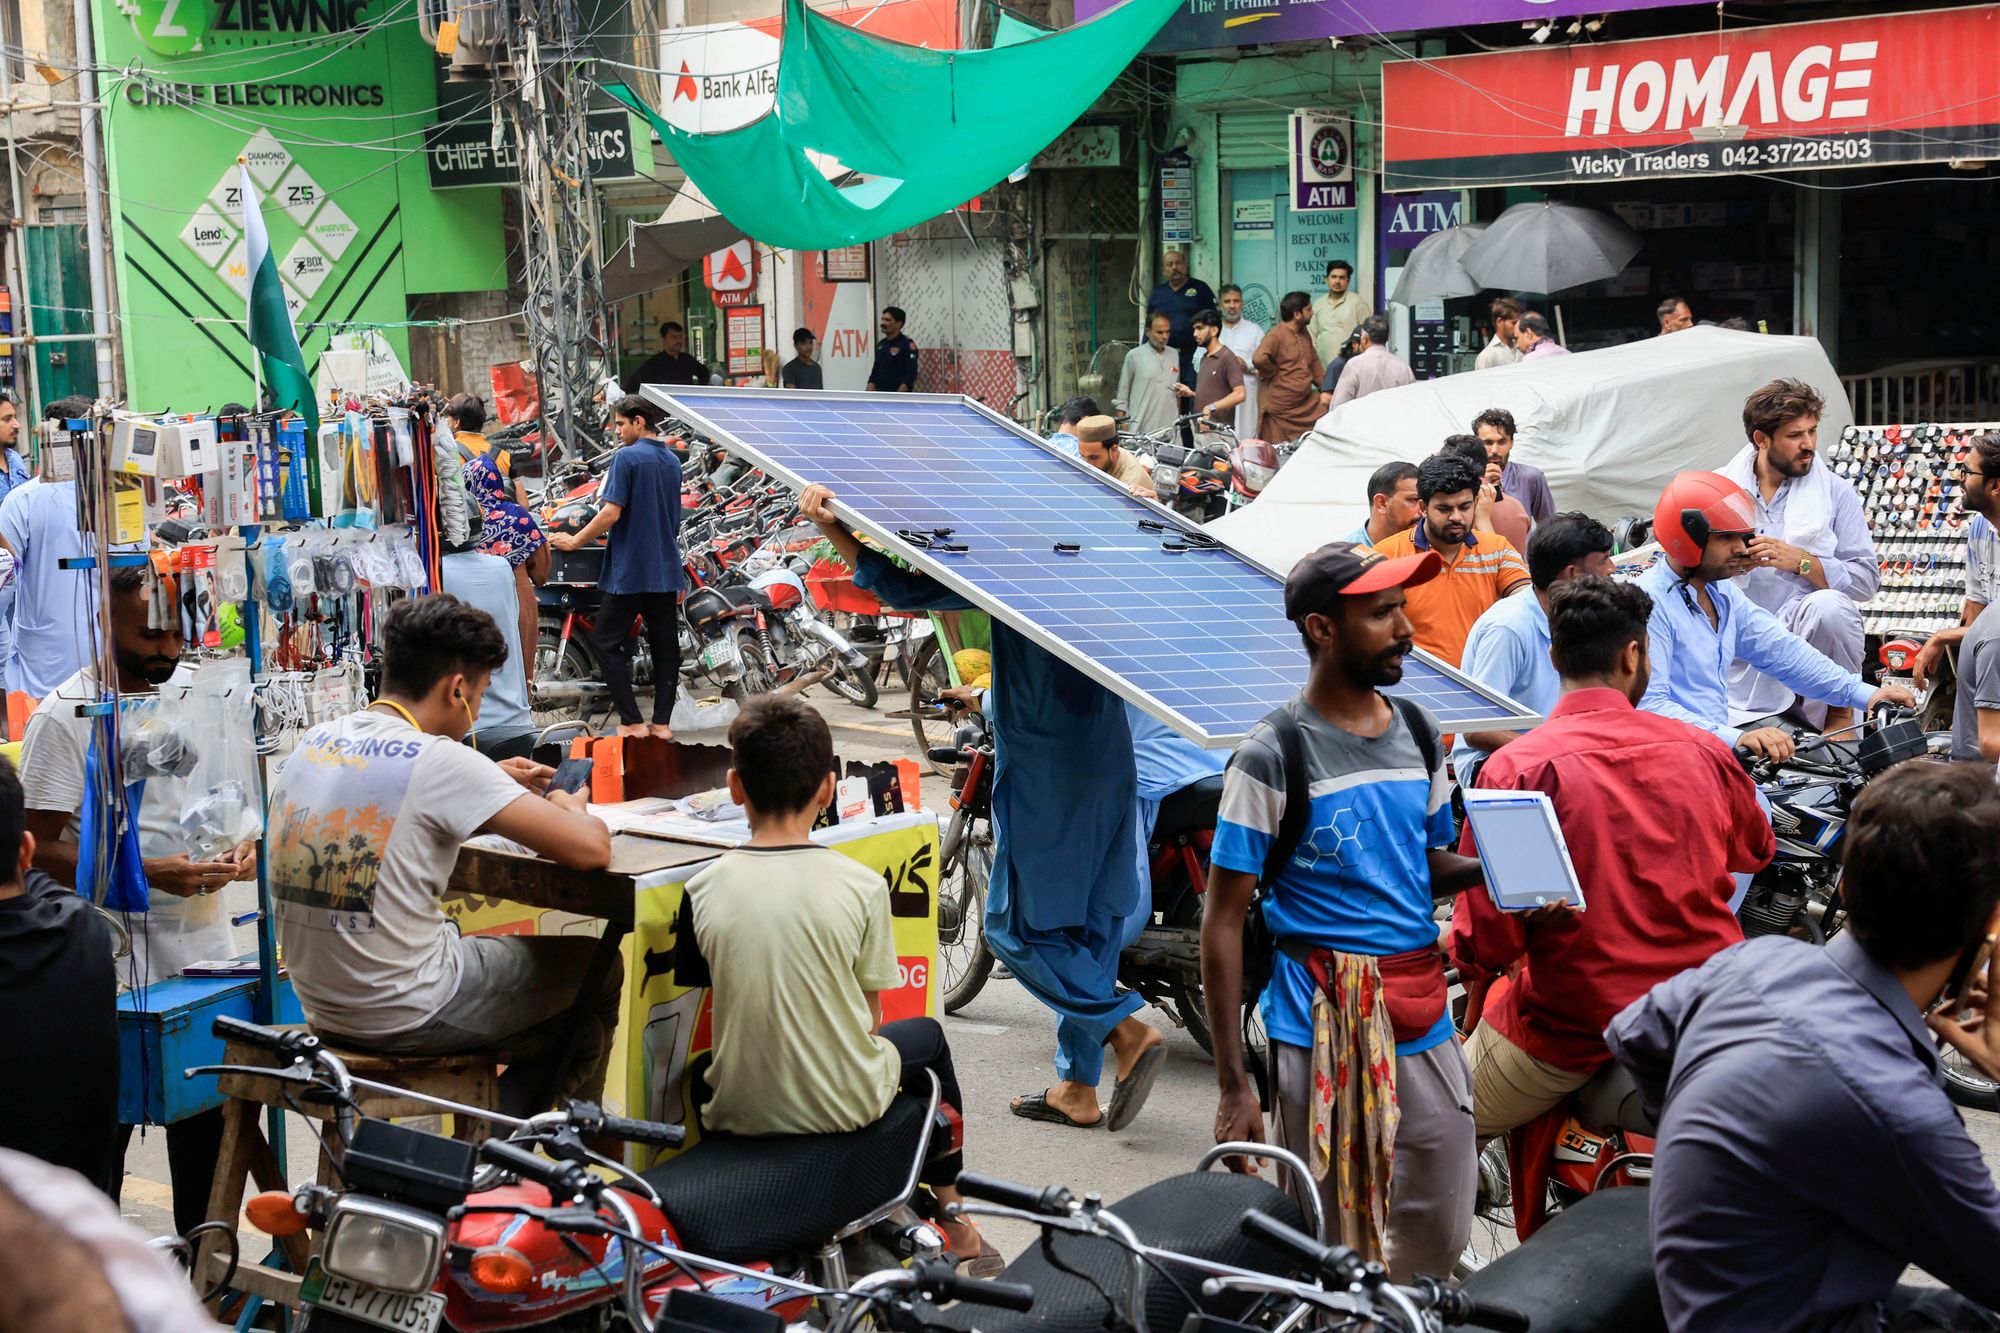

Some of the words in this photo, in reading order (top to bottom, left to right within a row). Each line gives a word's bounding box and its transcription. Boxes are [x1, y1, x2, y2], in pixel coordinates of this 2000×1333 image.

[1187, 0, 1216, 14] The
[214, 0, 369, 33] ZIEWNIC
[210, 37, 272, 46] Solar
[703, 74, 742, 100] Bank
[745, 69, 779, 96] Alfa
[1563, 41, 1879, 137] HOMAGE
[125, 83, 205, 106] CHIEF
[213, 84, 384, 106] ELECTRONICS
[248, 152, 286, 160] DIAMOND
[434, 138, 489, 173] CHIEF
[494, 129, 626, 169] ELNICS
[1572, 155, 1626, 178] Vicky
[1633, 152, 1710, 171] Traders
[1722, 138, 1873, 166] 042-37226503
[288, 186, 315, 203] Z5
[1308, 187, 1346, 206] ATM
[1297, 213, 1345, 226] WELCOME
[1388, 202, 1462, 233] ATM
[1292, 233, 1317, 246] BEST
[1320, 232, 1351, 246] BANK
[1313, 247, 1328, 258] OF
[1294, 260, 1329, 272] PAKIST
[1310, 278, 1327, 289] 202
[719, 293, 742, 304] ATM
[831, 328, 869, 359] ATM
[1772, 827, 1802, 835] ONDA
